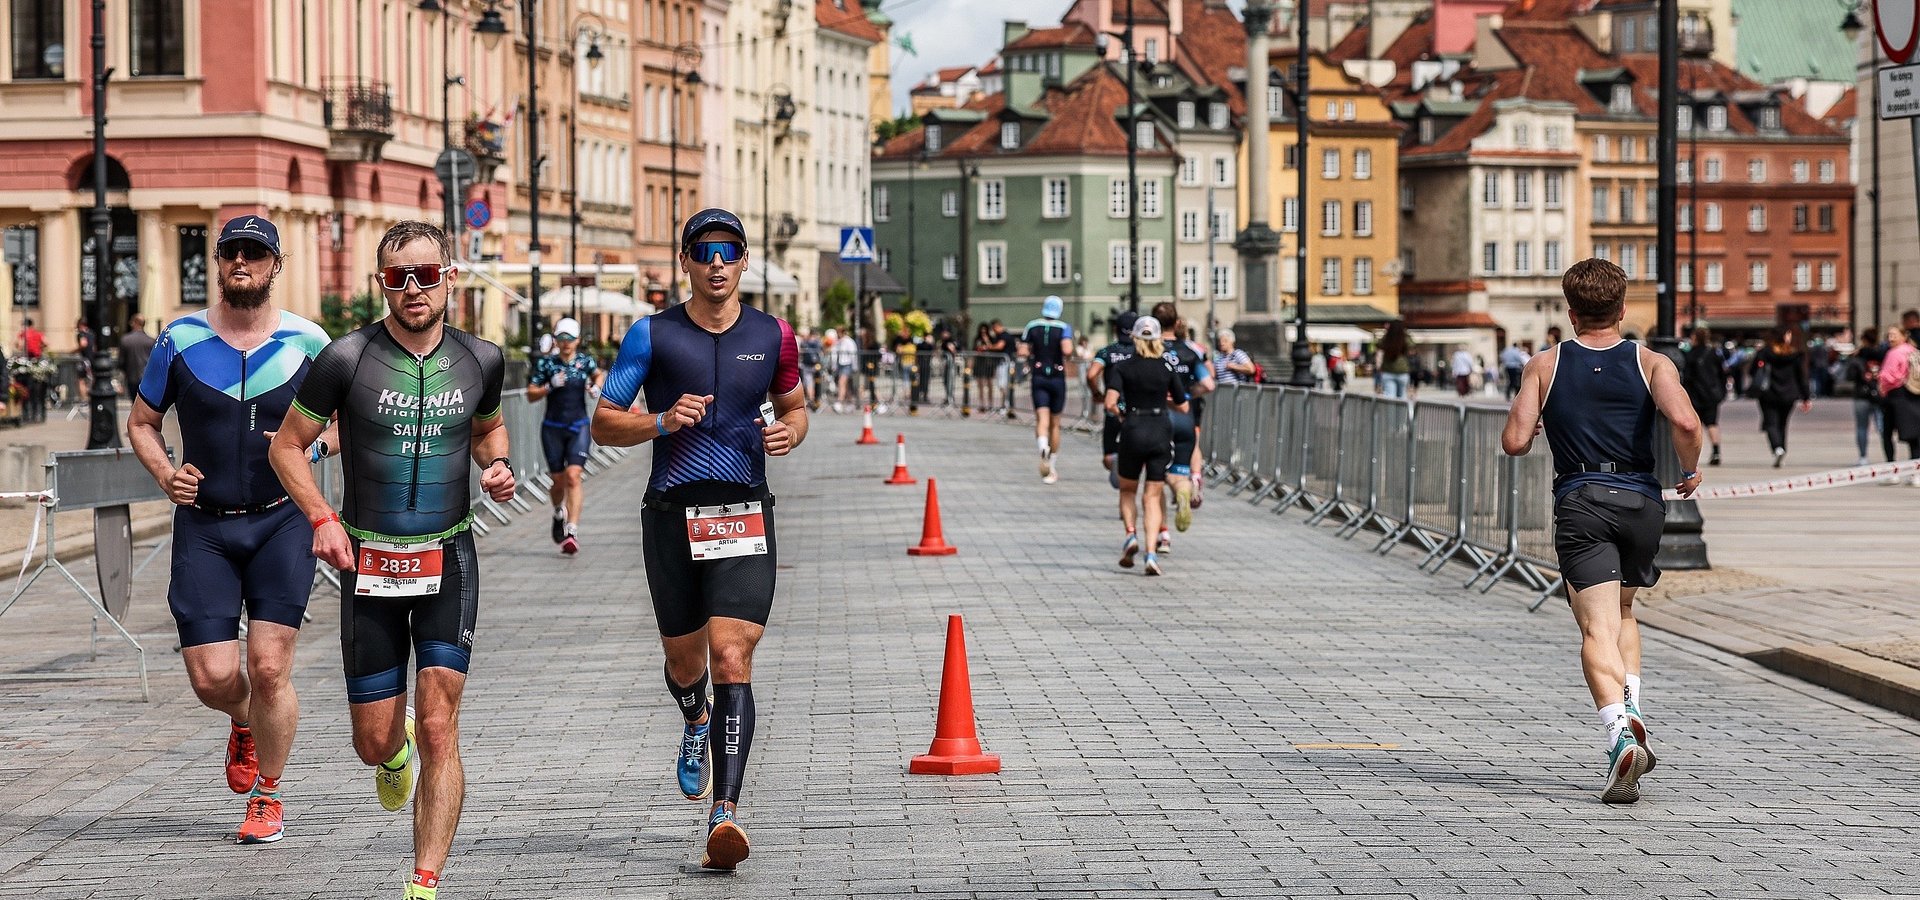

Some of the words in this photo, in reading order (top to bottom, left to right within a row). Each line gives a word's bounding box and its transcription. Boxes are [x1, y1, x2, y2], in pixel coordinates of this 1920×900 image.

[393, 423, 443, 437] SAWIK
[402, 441, 432, 454] POL
[707, 521, 746, 536] 2670
[380, 557, 421, 573] 2832
[383, 577, 417, 586] SEBASTIAN
[725, 715, 740, 755] HUUB
